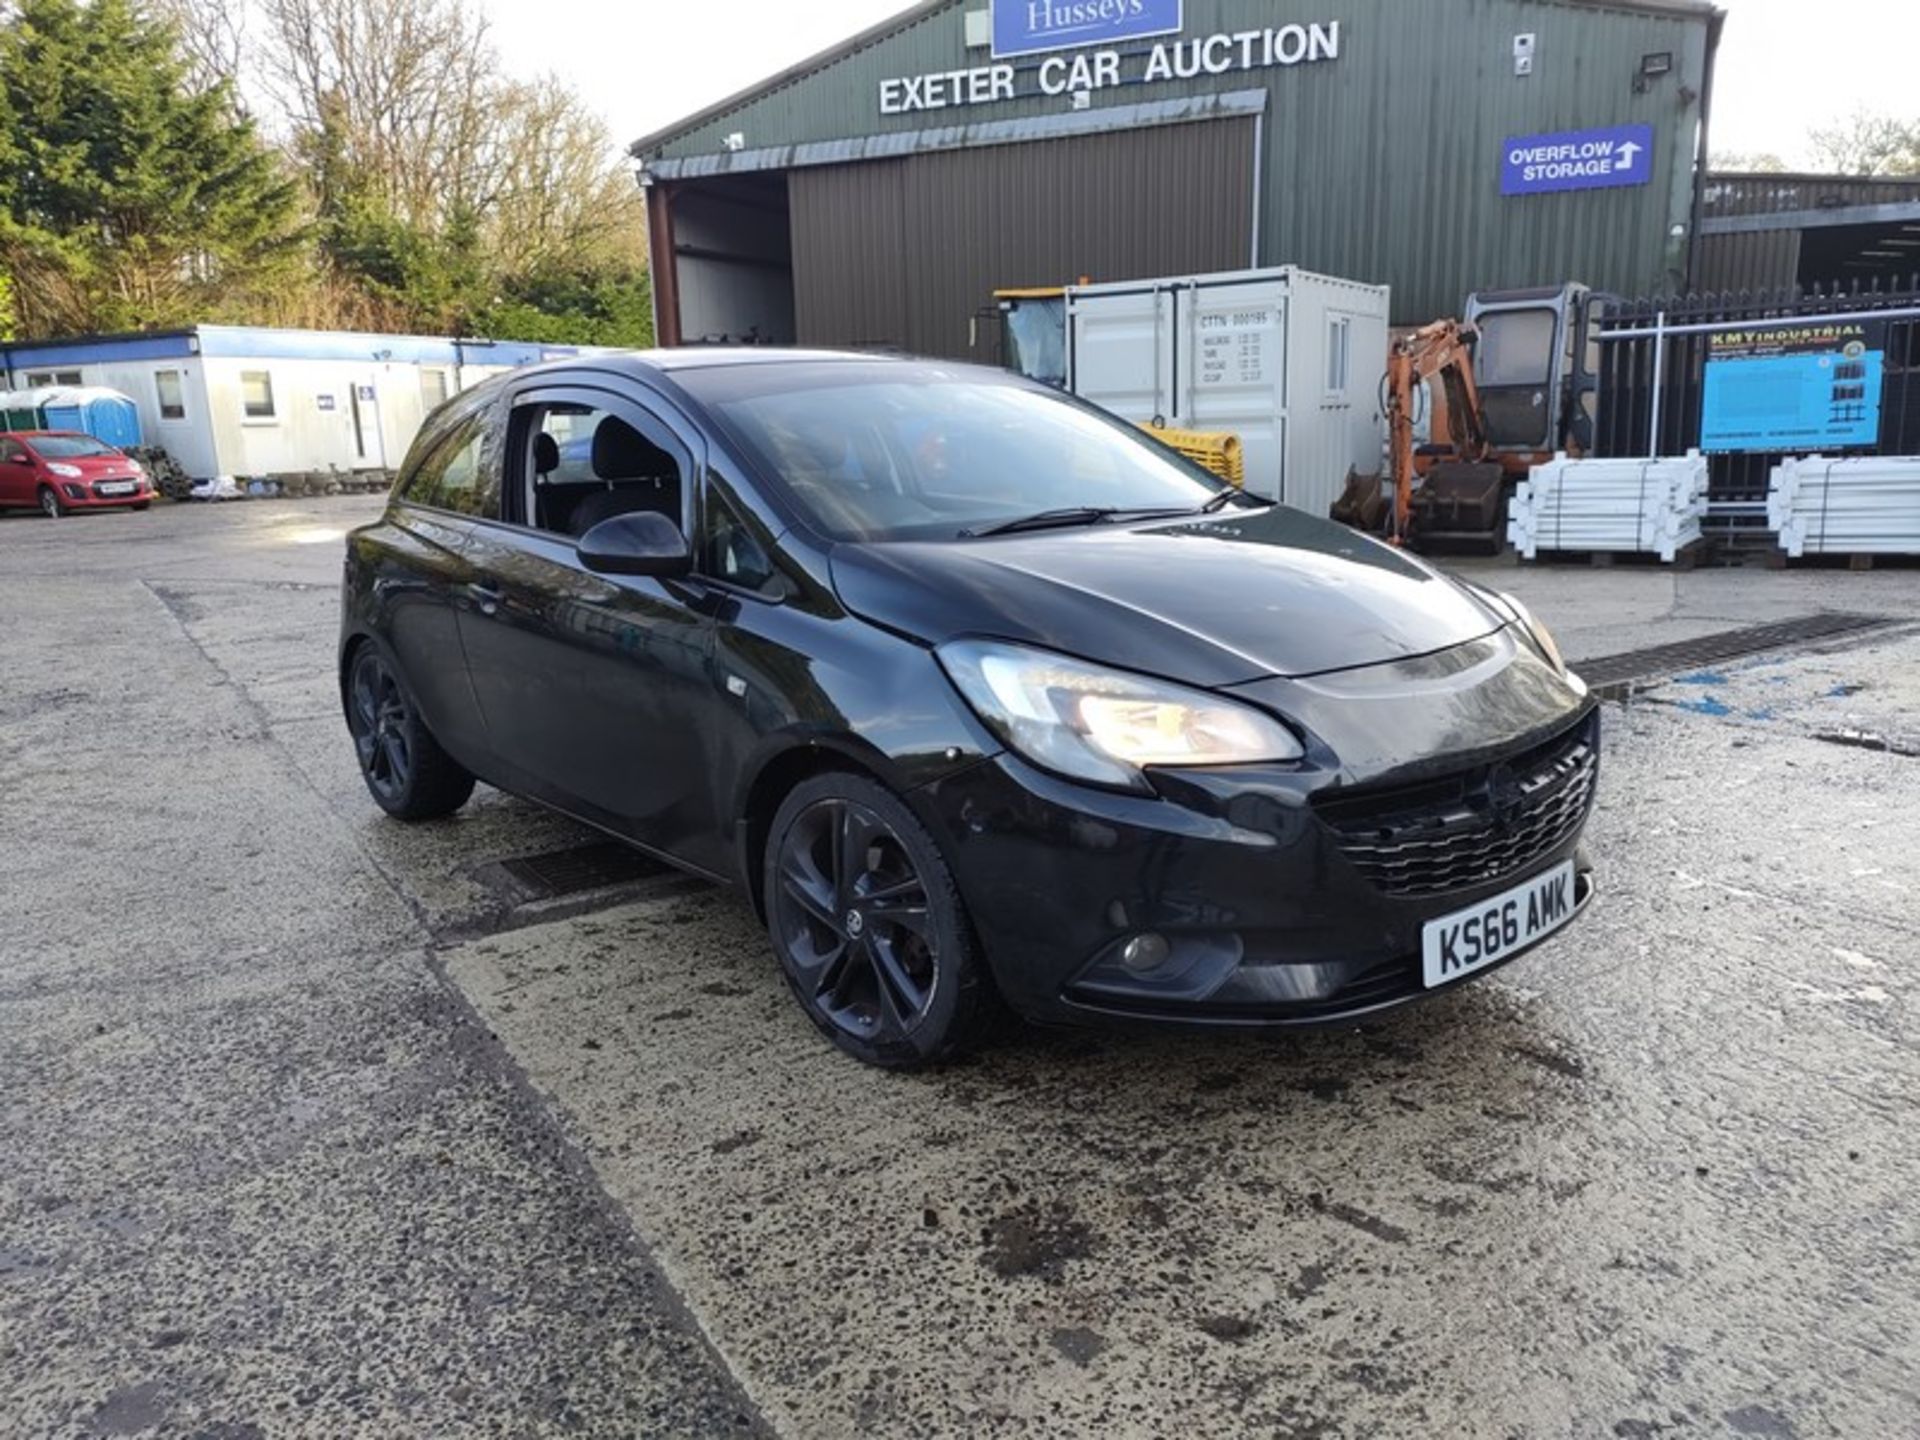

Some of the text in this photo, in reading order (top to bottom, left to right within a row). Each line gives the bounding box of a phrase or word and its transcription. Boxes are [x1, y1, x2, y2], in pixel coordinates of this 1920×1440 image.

[1028, 0, 1143, 31] Husseys
[880, 21, 1340, 114] EXETER CAR AUCTION
[1509, 141, 1614, 165] OVERFLOW
[1523, 159, 1611, 181] STORAGE
[1440, 872, 1568, 974] KS66 AMK
